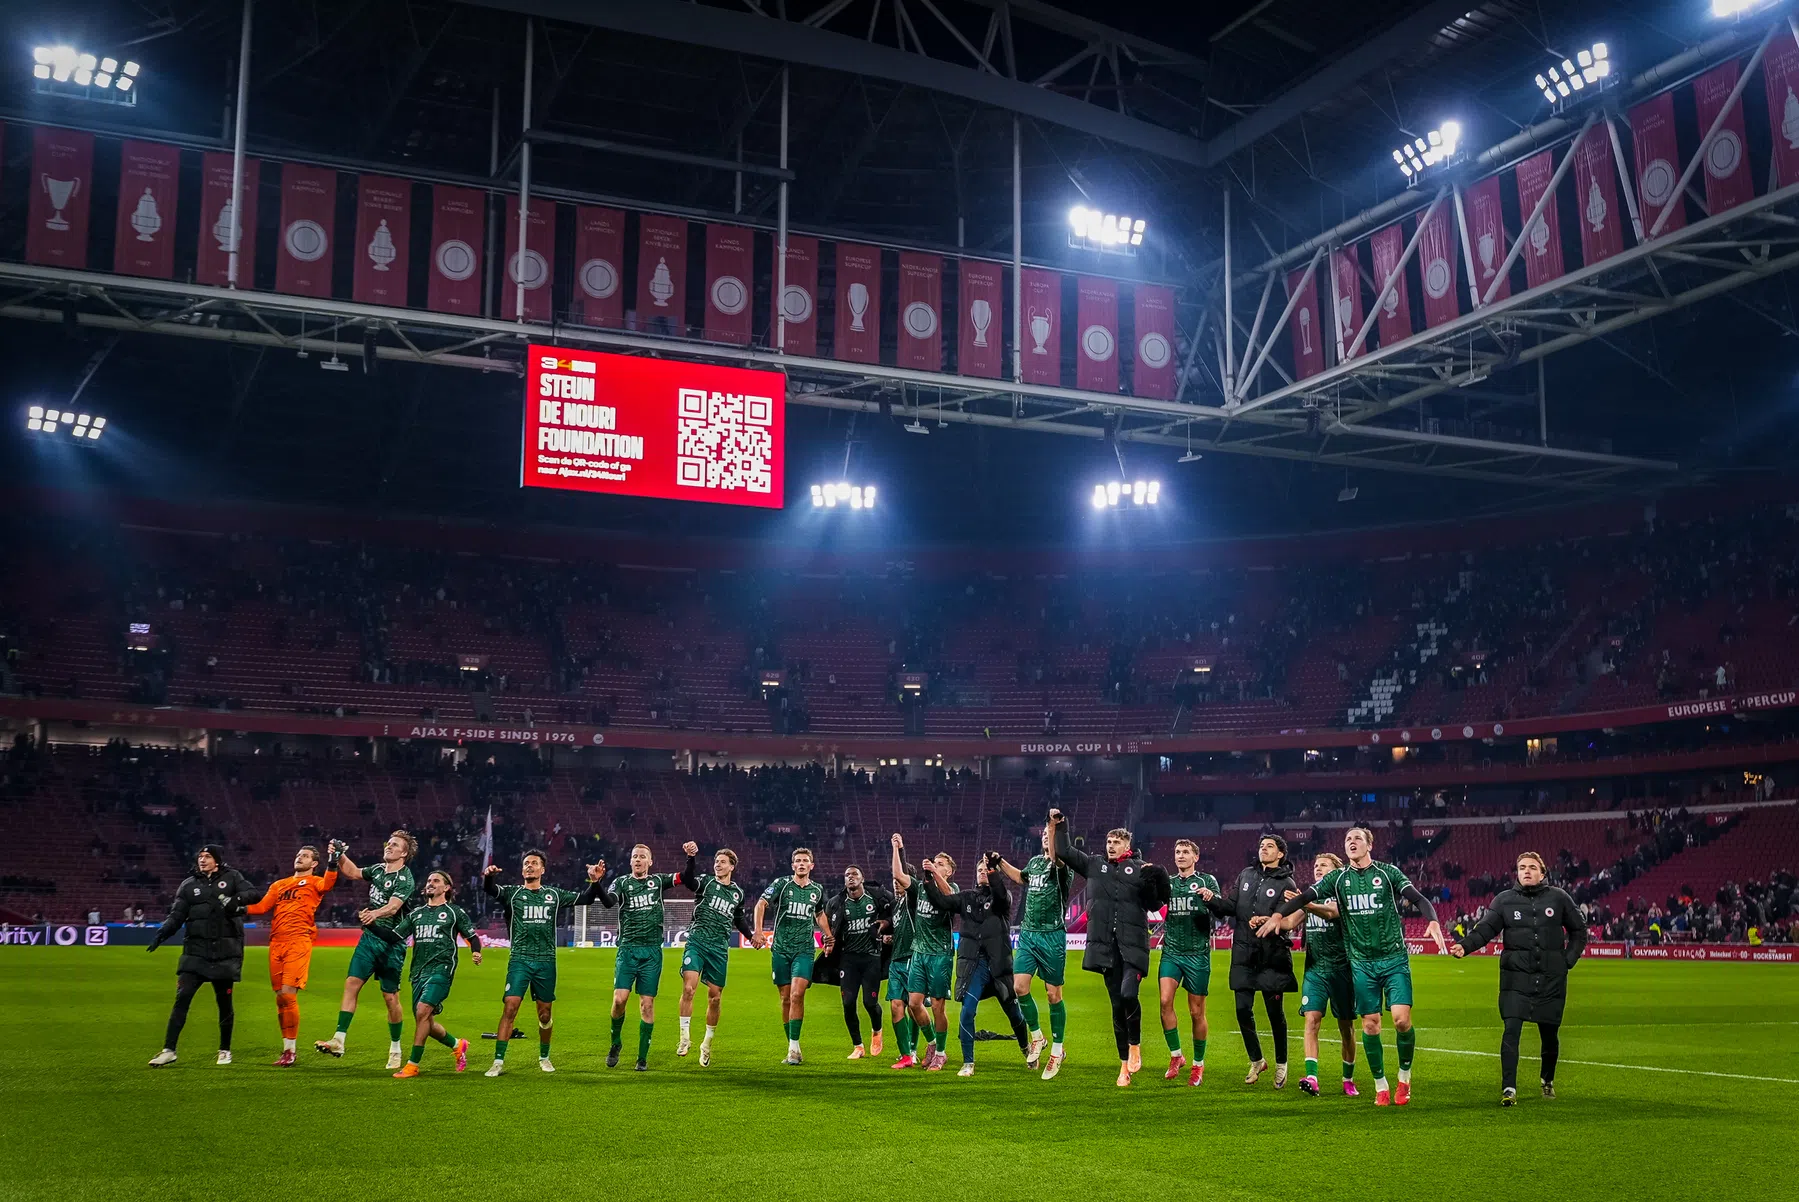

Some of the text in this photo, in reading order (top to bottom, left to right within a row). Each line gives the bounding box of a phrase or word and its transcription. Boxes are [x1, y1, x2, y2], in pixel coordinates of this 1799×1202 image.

[540, 373, 595, 401] STEUN
[539, 399, 616, 430] DE NOURI
[538, 427, 644, 460] FOUNDATION
[538, 455, 632, 472] Scan de QR-code of ga
[538, 467, 558, 475] naar
[1667, 700, 1727, 718] EUROPESE
[411, 727, 576, 742] AJAX F-SIDE SINDS 1976
[1021, 744, 1072, 753] EUROPA
[1076, 743, 1102, 752] CUP
[1634, 948, 1668, 957] OLYMPIA
[1709, 950, 1732, 958] Heineken
[1753, 952, 1792, 960] ROCKSTARS IT
